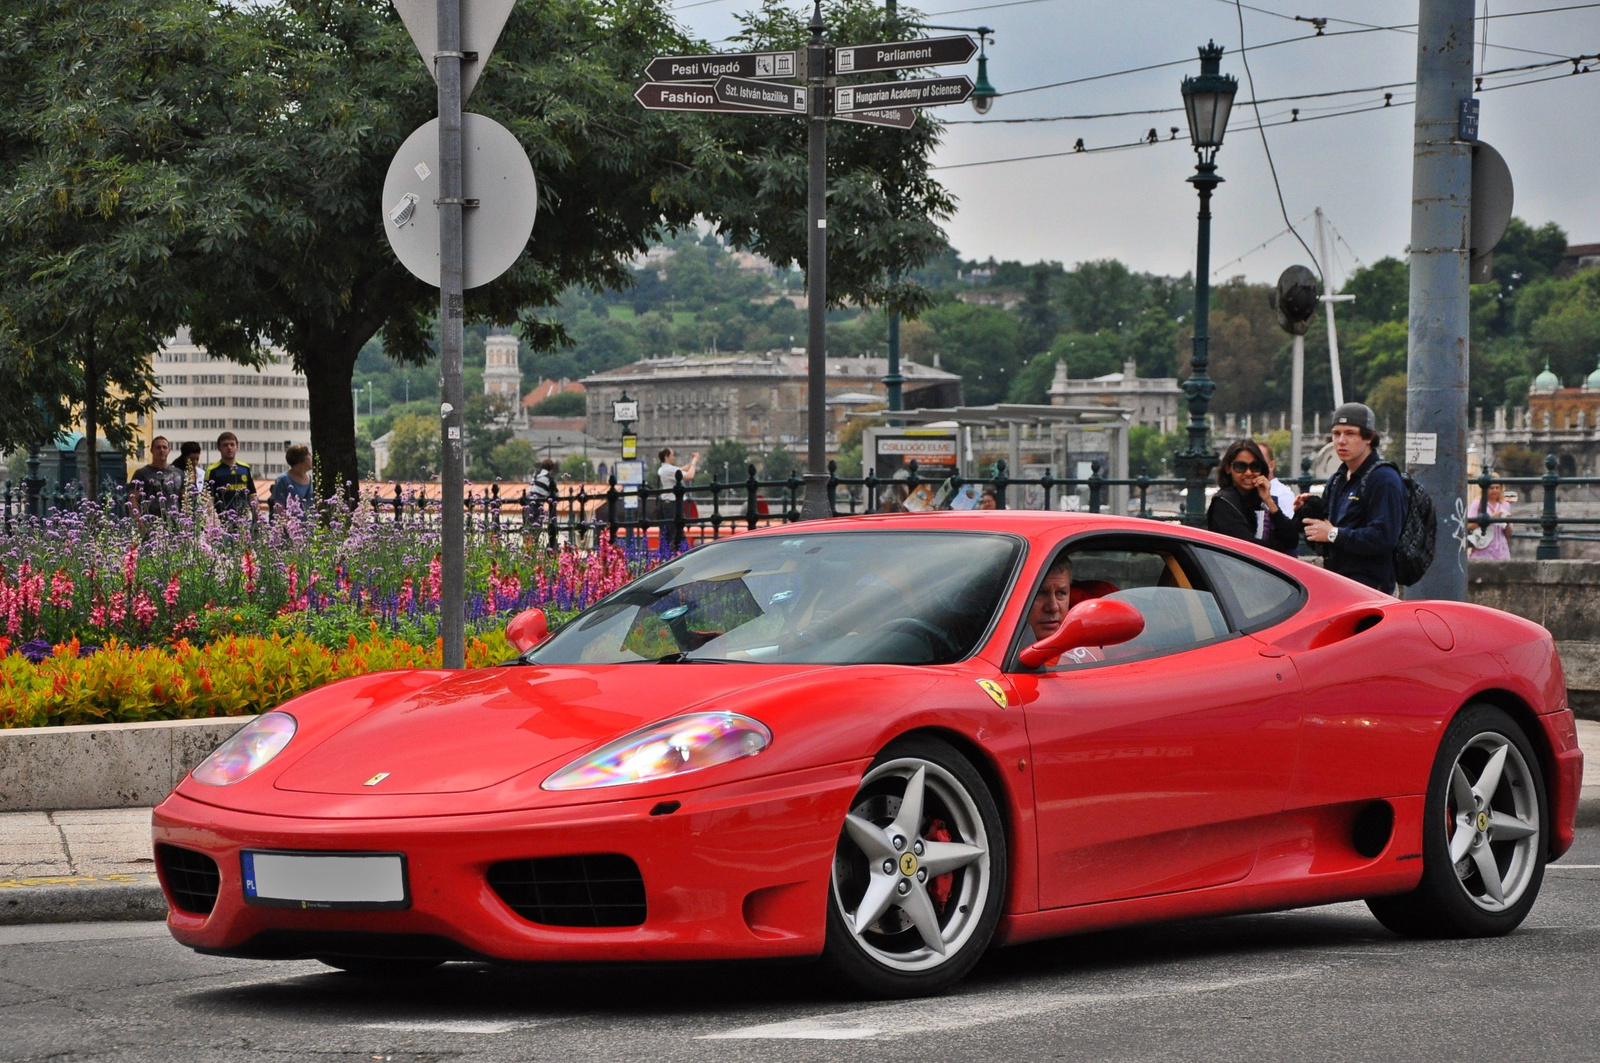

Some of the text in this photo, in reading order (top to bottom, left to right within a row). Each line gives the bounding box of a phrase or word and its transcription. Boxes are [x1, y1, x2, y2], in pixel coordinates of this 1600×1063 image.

[877, 47, 932, 62] Parliament
[671, 61, 740, 76] Pesti Vigadó
[660, 91, 714, 104] Fashion
[725, 84, 789, 103] Szt. István bazilika
[855, 84, 962, 104] Hungarian Academy of Sciences
[246, 879, 256, 889] PL
